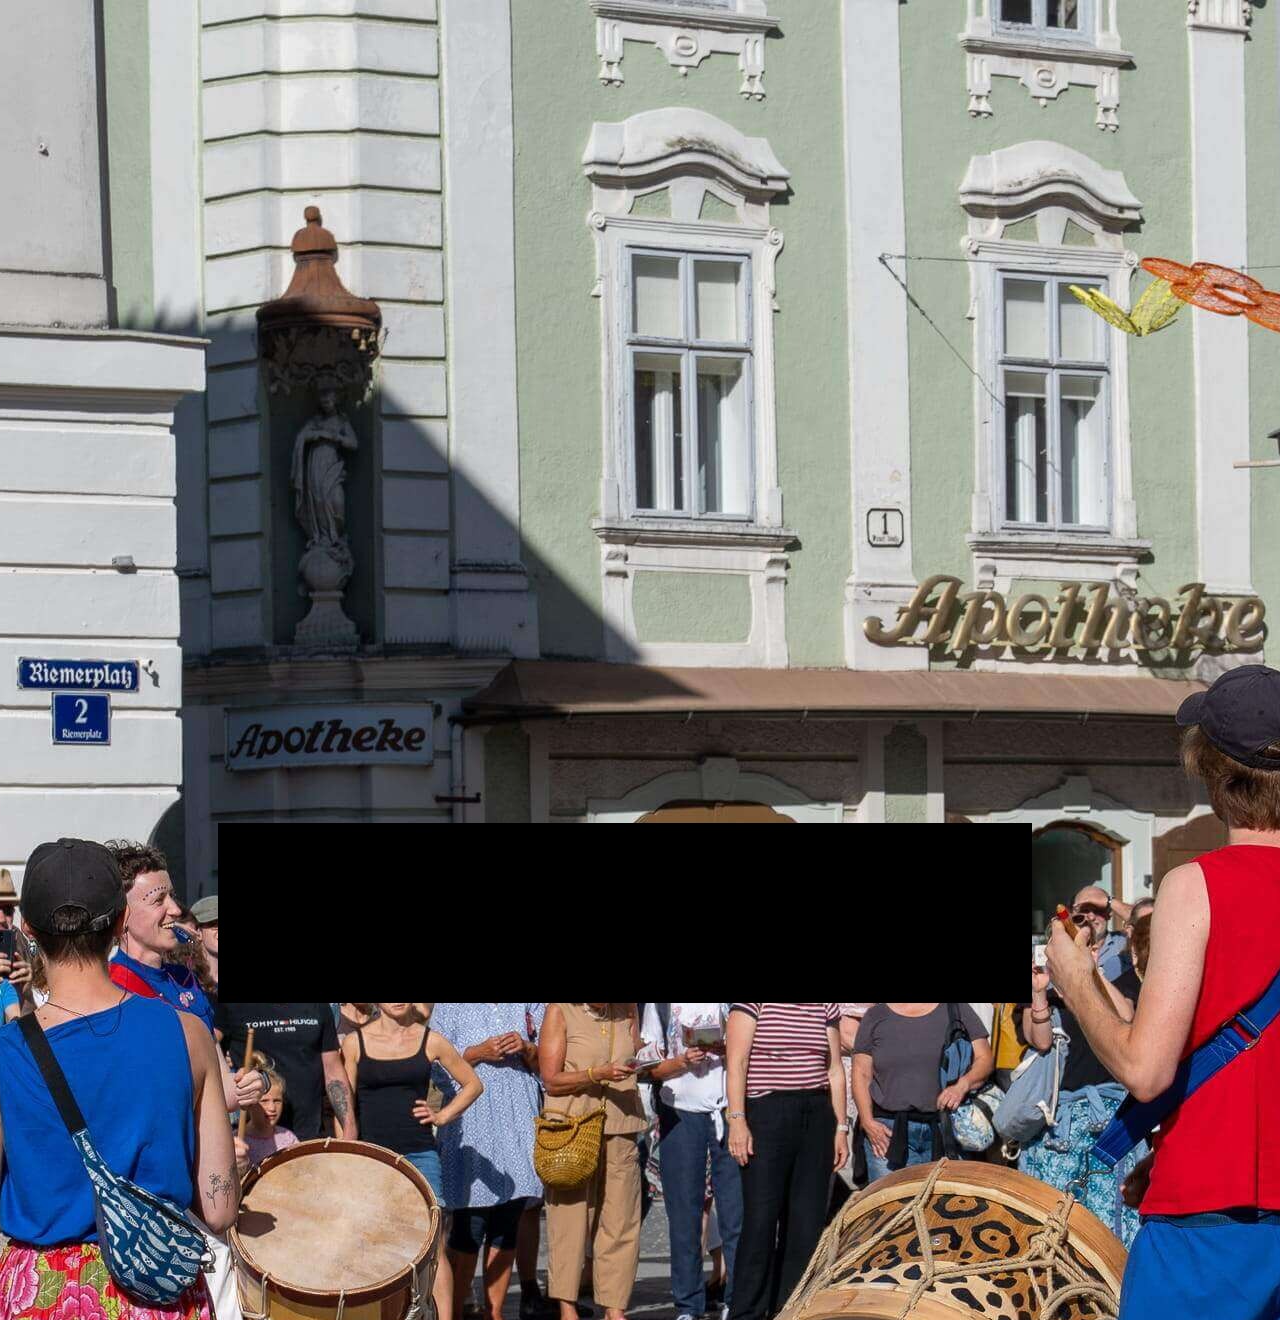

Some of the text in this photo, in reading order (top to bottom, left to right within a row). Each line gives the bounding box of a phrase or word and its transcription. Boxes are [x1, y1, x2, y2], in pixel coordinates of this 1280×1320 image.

[881, 512, 888, 535] 1
[862, 574, 1266, 652] Apotheke
[28, 662, 133, 689] Riemerplatz
[74, 698, 89, 724] 2
[61, 728, 103, 740] Riemerplatz
[229, 718, 426, 759] Apotheke
